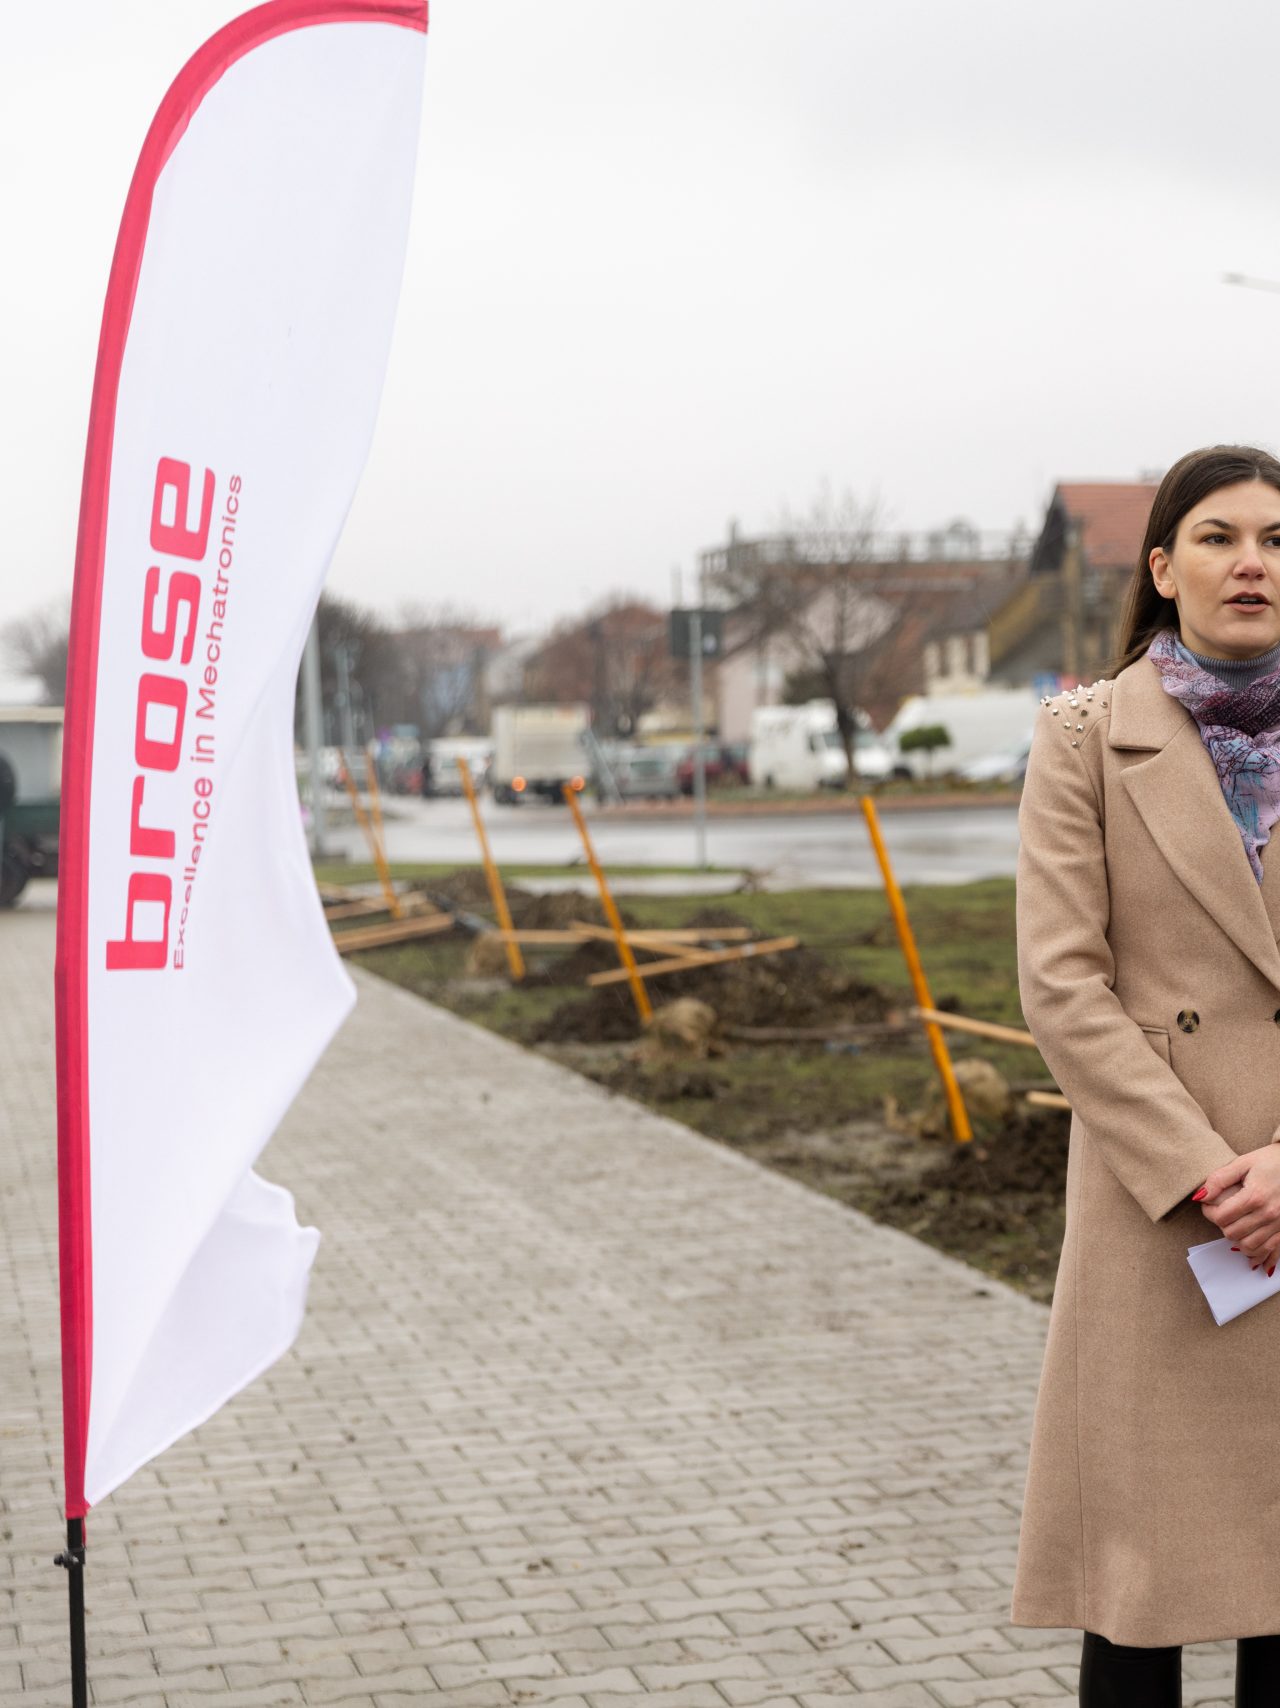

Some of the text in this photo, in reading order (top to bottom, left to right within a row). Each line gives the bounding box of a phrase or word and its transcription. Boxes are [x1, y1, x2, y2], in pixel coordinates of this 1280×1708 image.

[105, 456, 216, 971] brose
[173, 474, 242, 970] Excellence in Mechatronics
